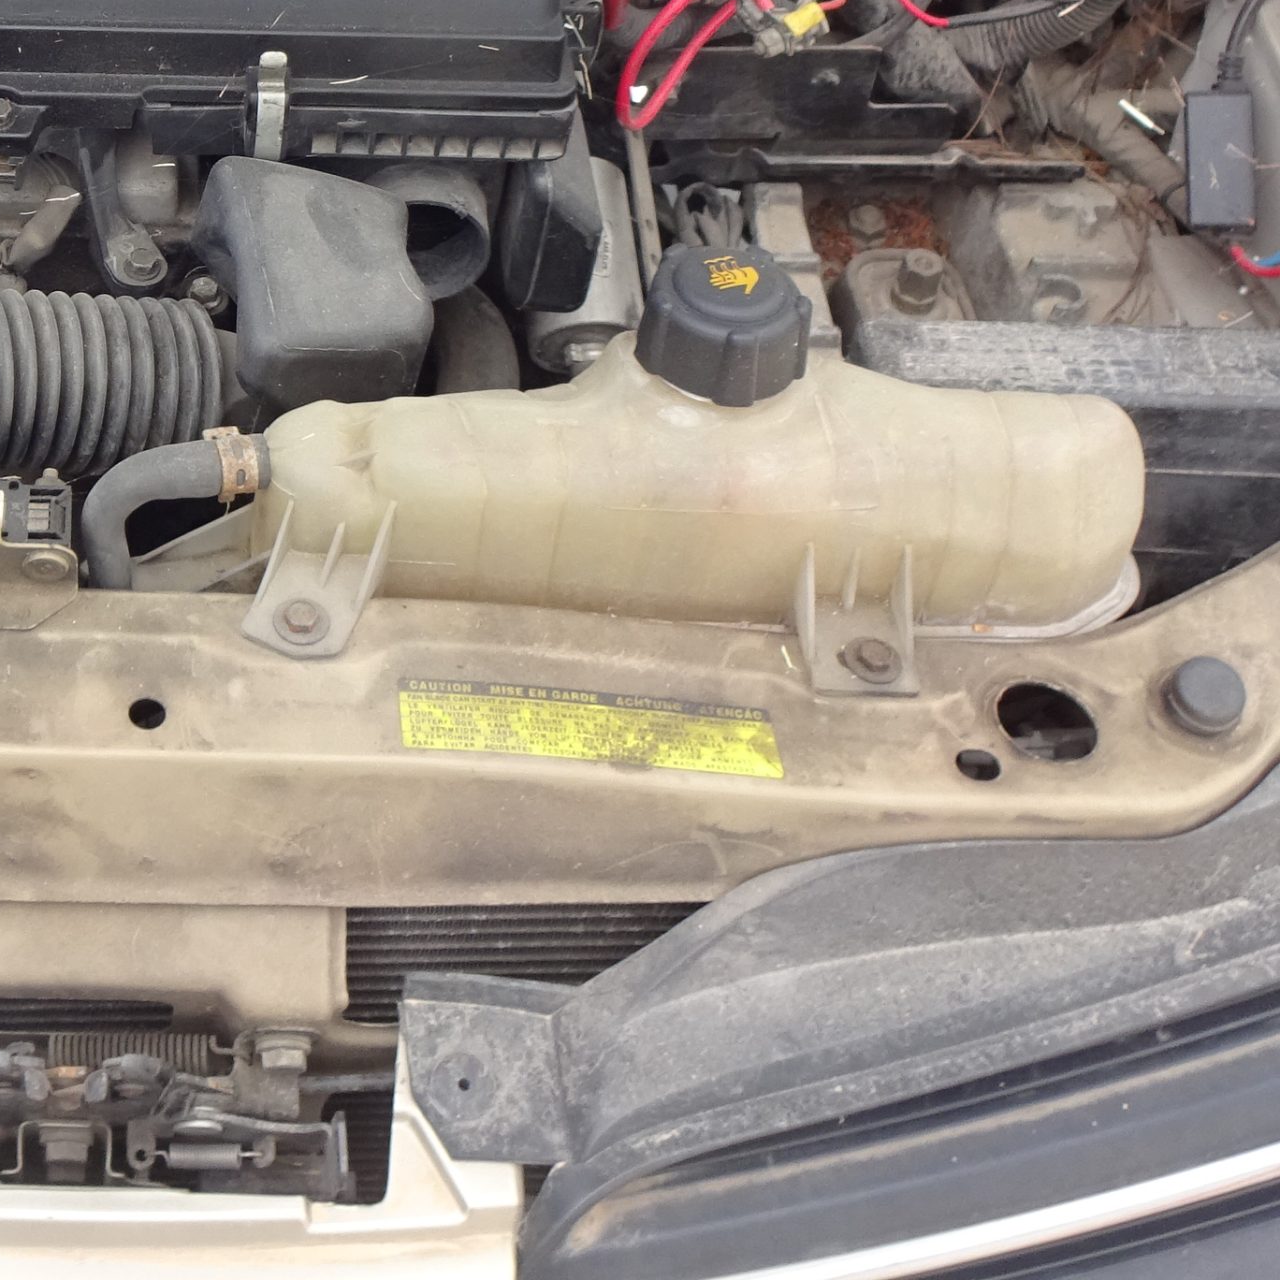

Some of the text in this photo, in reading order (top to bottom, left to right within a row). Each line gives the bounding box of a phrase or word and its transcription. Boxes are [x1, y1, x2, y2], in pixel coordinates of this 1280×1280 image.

[409, 680, 598, 703] CAUTION MISE EN GARDE
